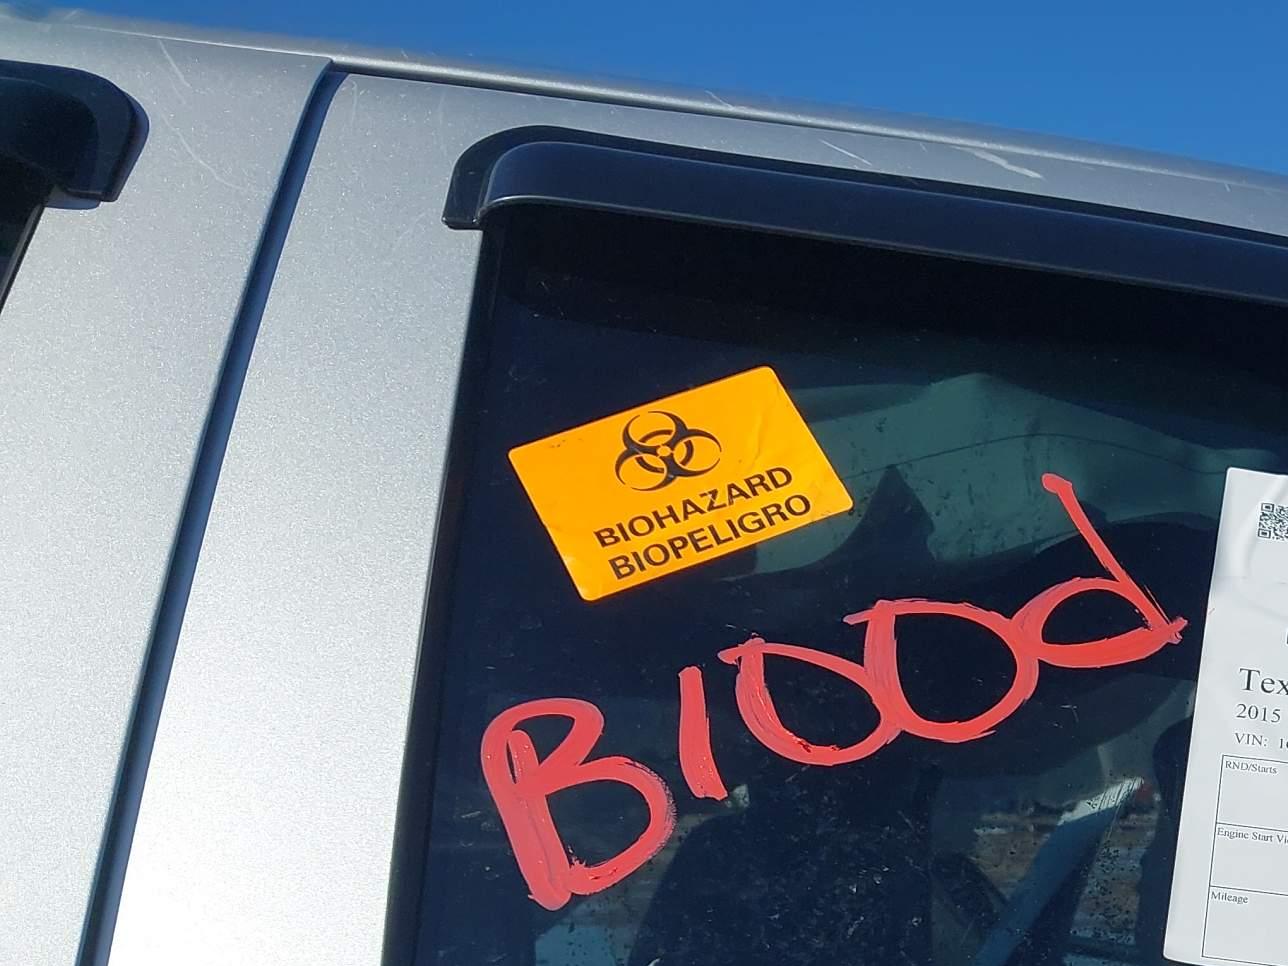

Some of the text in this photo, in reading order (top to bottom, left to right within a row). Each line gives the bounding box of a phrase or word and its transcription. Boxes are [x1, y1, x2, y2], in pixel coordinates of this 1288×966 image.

[593, 466, 793, 549] BIOHAZARD
[608, 494, 812, 580] BIOPELIGRO
[1236, 703, 1281, 723] 2015
[1234, 732, 1268, 747] VIN:
[1225, 760, 1278, 774] RND/Starts
[1217, 827, 1249, 842] Engine
[1251, 832, 1274, 842] Start
[1210, 891, 1249, 905] Mileage
